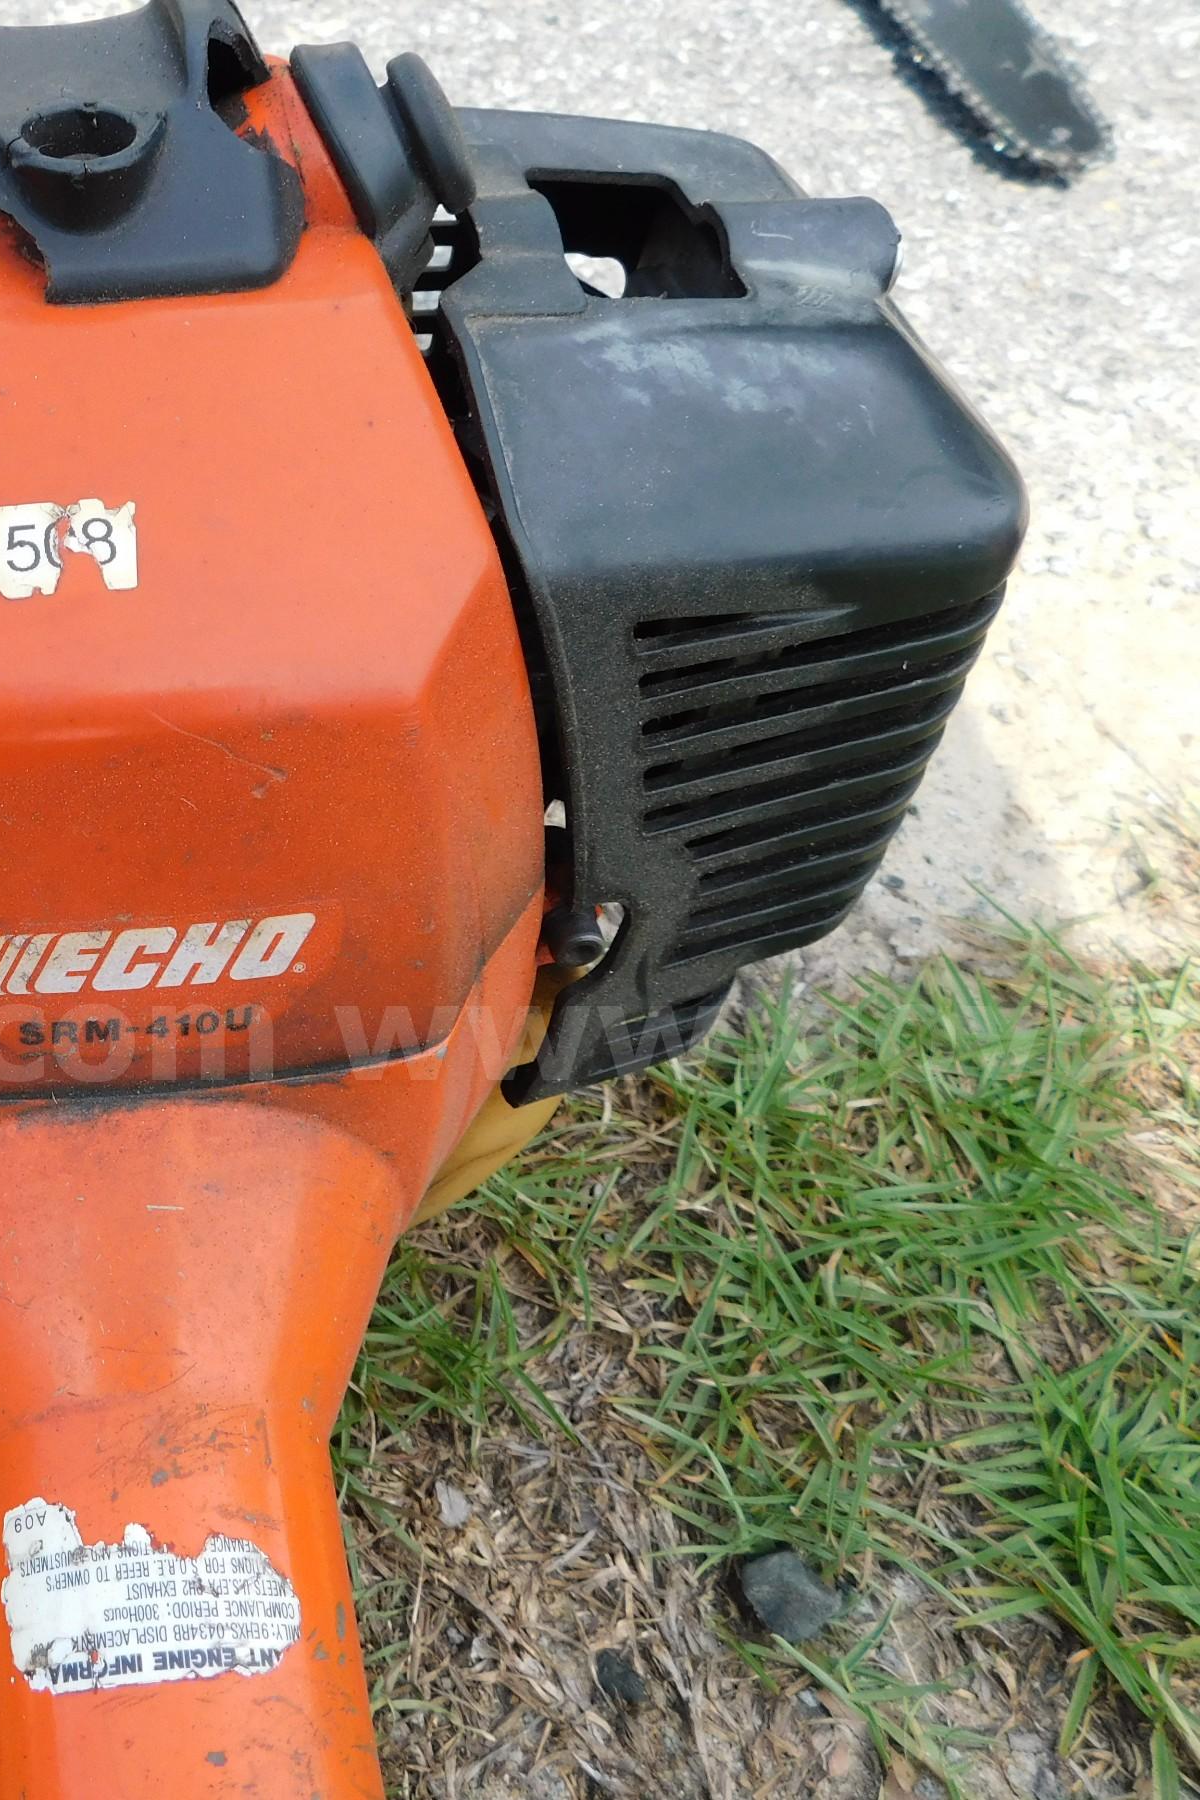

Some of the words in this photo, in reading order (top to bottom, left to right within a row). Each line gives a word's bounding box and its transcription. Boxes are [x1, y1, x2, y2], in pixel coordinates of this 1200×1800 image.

[34, 912, 316, 995] ECHO
[19, 1006, 253, 1046] SRM-410U
[14, 1510, 47, 1533] A09
[96, 1567, 110, 1583] TO
[115, 1560, 150, 1580] REFER
[205, 1556, 226, 1574] FOR
[46, 1569, 90, 1592] OWNER'S
[126, 1580, 177, 1601] EXHAUST
[255, 1578, 286, 1597] MEETS
[103, 1602, 160, 1622] 300Hours
[167, 1600, 219, 1620] PERIOD:
[224, 1600, 295, 1619] COMPLIANCE
[152, 1648, 236, 1672] ENGINE
